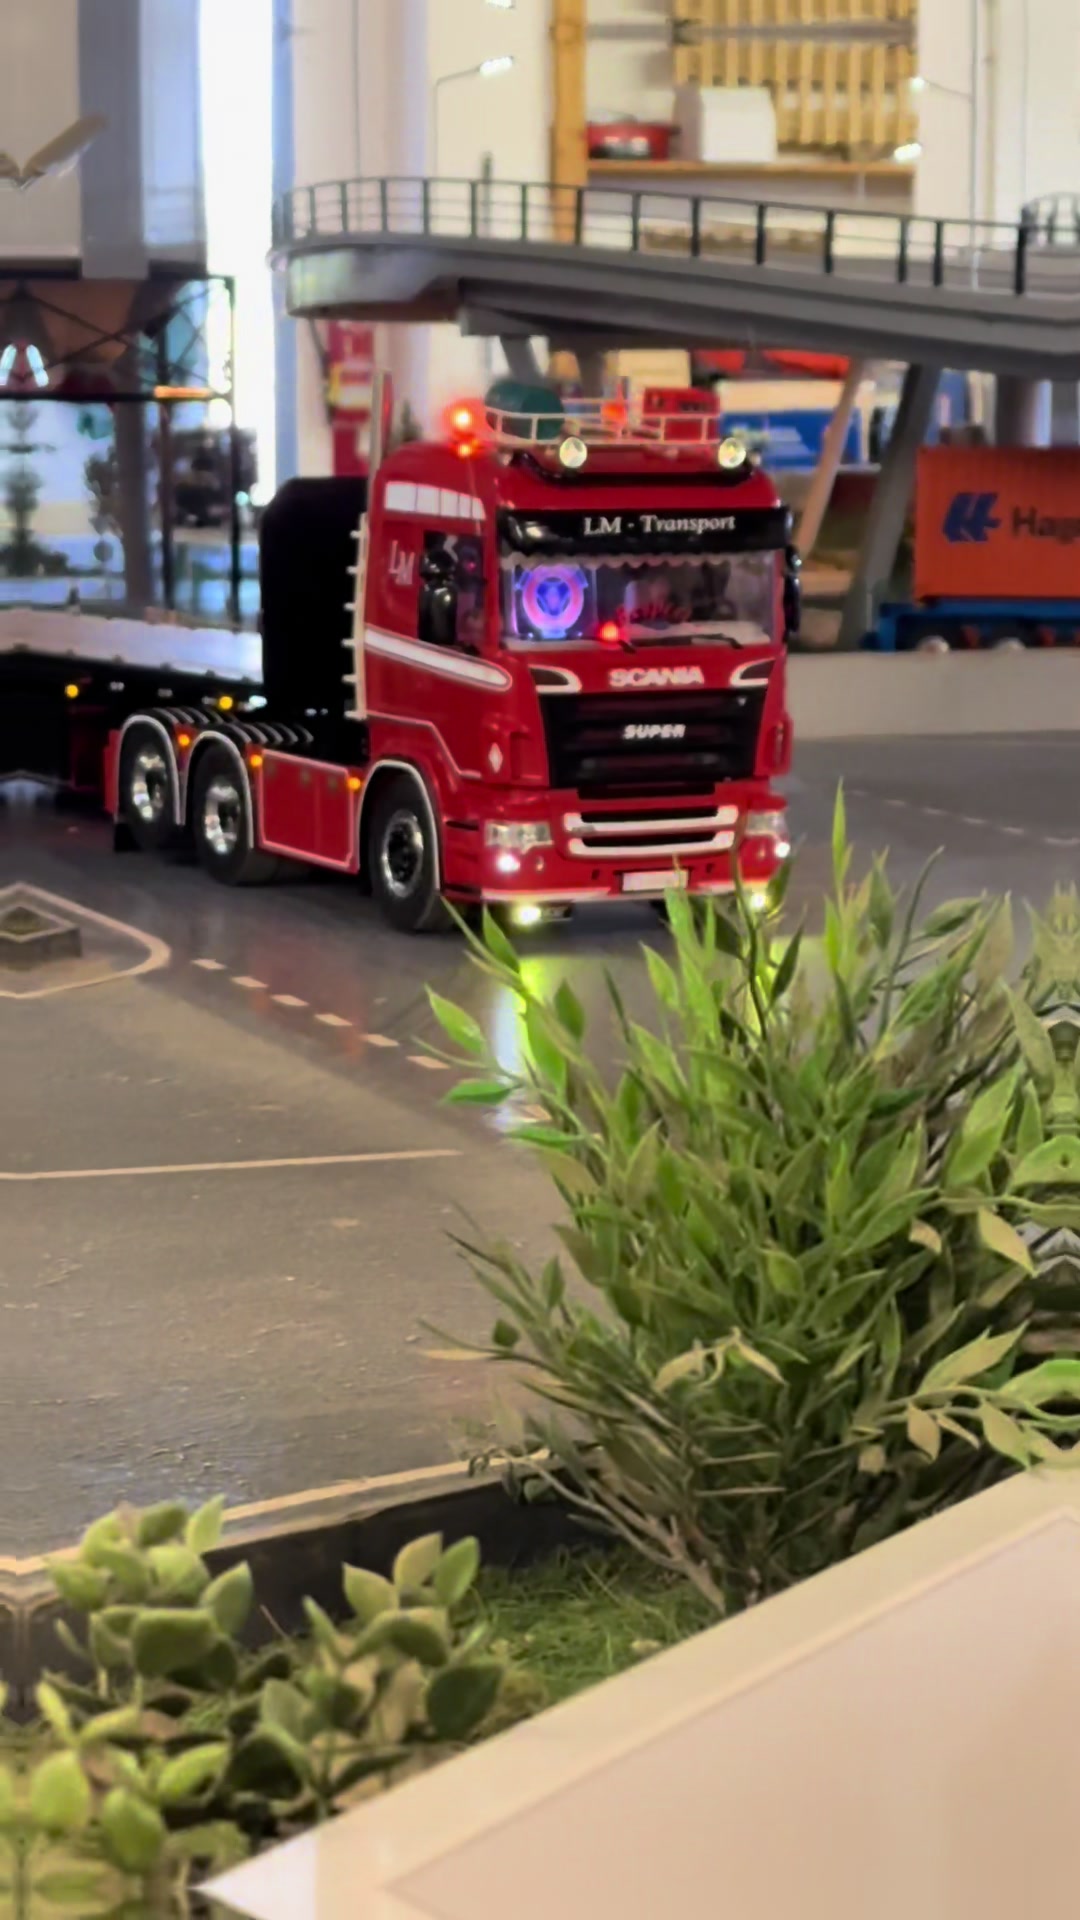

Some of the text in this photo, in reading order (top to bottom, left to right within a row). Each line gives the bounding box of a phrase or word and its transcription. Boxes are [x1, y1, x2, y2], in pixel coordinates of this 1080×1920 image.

[583, 516, 622, 535] LM
[640, 514, 736, 534] Transport
[388, 540, 416, 585] LM
[608, 666, 705, 688] SCANIA
[623, 723, 687, 740] SUPER
